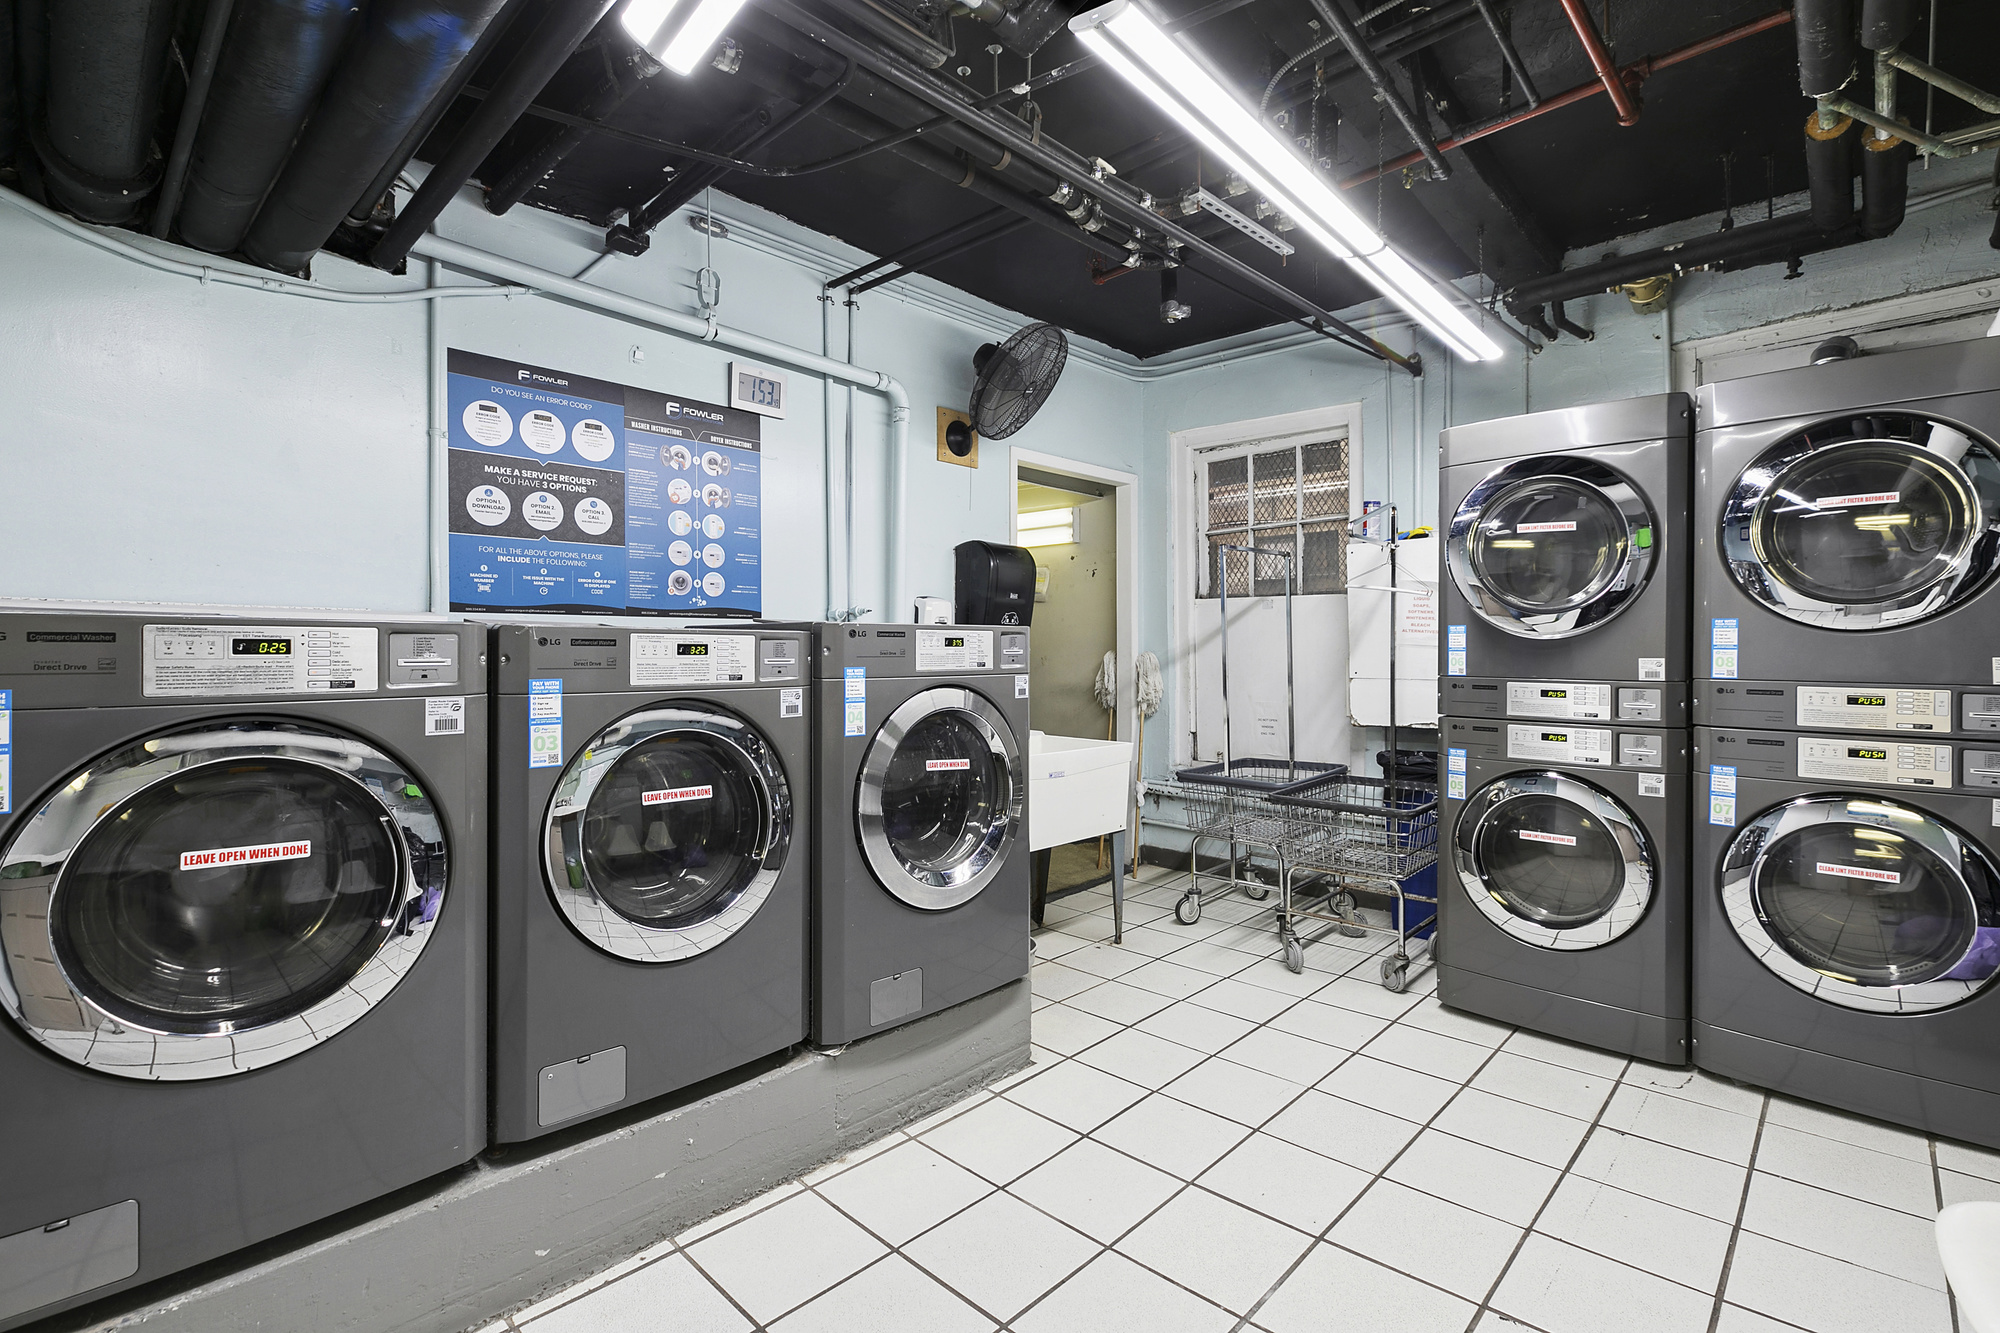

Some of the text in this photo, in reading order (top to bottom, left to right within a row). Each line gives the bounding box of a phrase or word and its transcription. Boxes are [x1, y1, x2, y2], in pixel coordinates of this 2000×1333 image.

[532, 374, 569, 386] FOWLER
[491, 386, 592, 411] DO YOU SEE AN ERROR CODE?
[683, 407, 724, 421] FOWLER
[631, 421, 683, 437] WASHER INSTRUCTIONS
[710, 435, 752, 449] DRYER INSTRUCTIONS
[484, 464, 598, 487] MAKE A SERVICE REQUEST:
[497, 475, 587, 493] YOU HAVE 3 OPTIONS
[472, 503, 506, 511] DOWNLOAD
[478, 545, 494, 553] FOR
[523, 549, 548, 557] ABOVE
[549, 550, 580, 559] OPTIONS,
[581, 552, 603, 561] PLEASE
[497, 555, 587, 567] INCLUDE THE FOLLOWING:
[29, 633, 114, 642] Commercial Washer
[857, 630, 867, 638] LG
[549, 638, 561, 646] LG
[33, 662, 88, 671] Direct Drive
[1450, 657, 1464, 666] 06
[1715, 656, 1735, 667] 08
[1857, 697, 1883, 705] PUSH
[847, 711, 863, 724] 04
[533, 735, 558, 752] 03
[1859, 750, 1885, 758] PUSH
[1450, 780, 1464, 790] 05
[643, 787, 711, 802] LEAVE OPEN WHEN DONE
[1713, 803, 1733, 815] 07
[184, 844, 309, 867] LEAVE OPEN WHEN DONE
[1818, 865, 1834, 873] CLEAN
[1865, 871, 1885, 879] BEFORE
